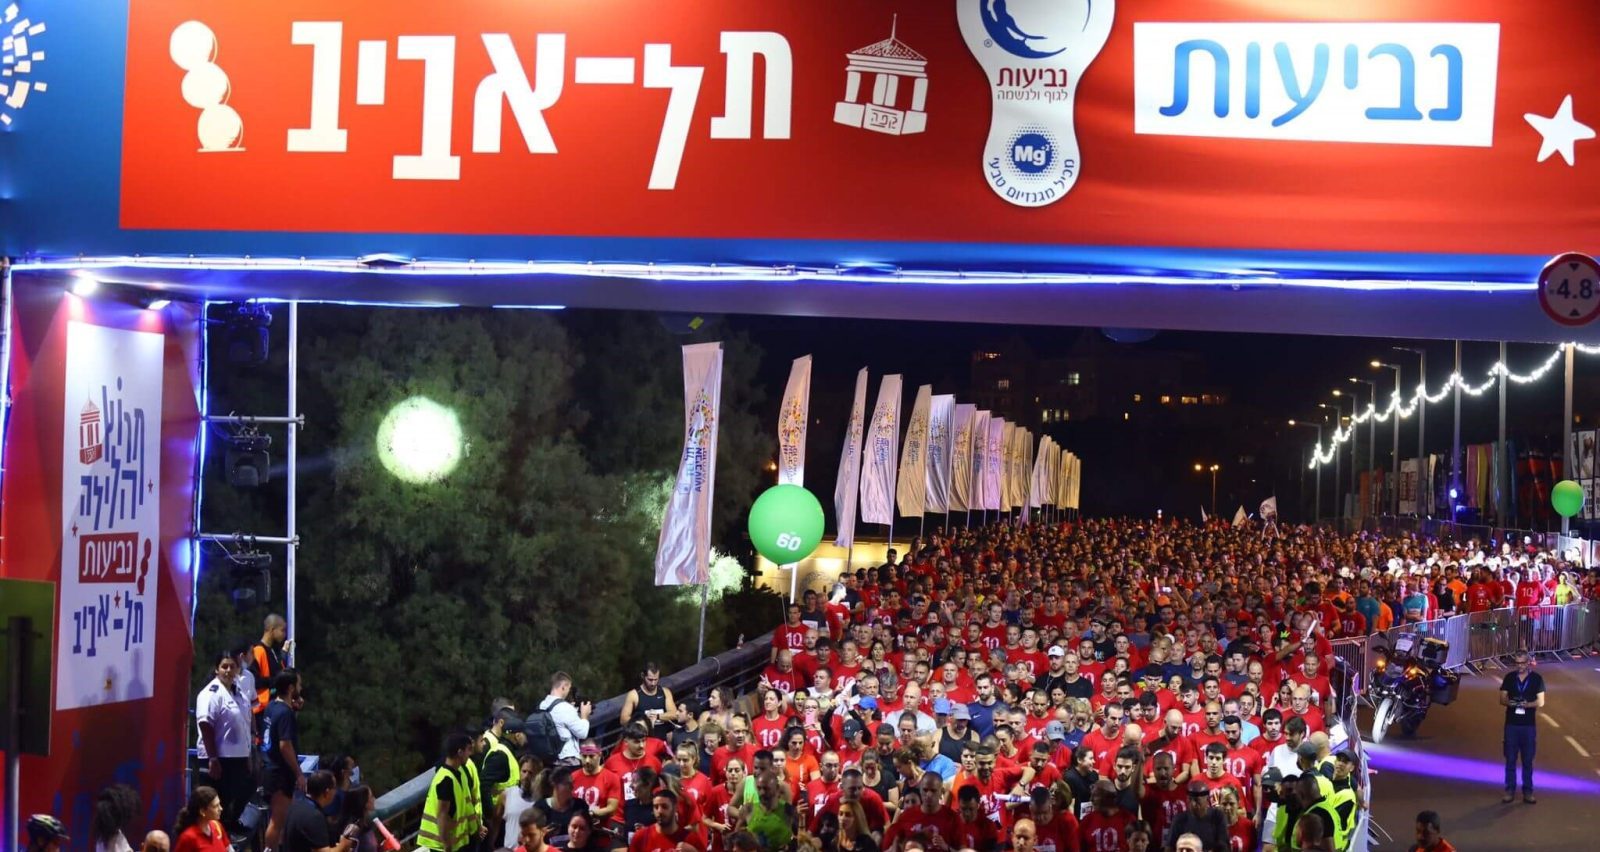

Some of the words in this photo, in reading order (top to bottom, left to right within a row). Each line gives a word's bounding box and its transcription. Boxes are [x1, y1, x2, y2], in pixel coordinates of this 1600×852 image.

[996, 67, 1067, 89] נביעות
[1158, 39, 1464, 127] נביעות
[997, 88, 1040, 101] ולנשמה
[1044, 88, 1068, 104] לגוף
[988, 157, 1007, 188] טבעי
[1053, 158, 1075, 190] מכיל
[1006, 187, 1056, 203] מגנזיום
[1556, 278, 1593, 300] 4.8
[80, 446, 138, 531] הלילה
[775, 532, 802, 551] 60
[82, 540, 133, 579] נביעות
[786, 632, 803, 647] 10
[983, 636, 999, 650] 10
[760, 728, 782, 748] 10
[1224, 757, 1247, 778] 10
[573, 785, 600, 807] 10
[1091, 827, 1119, 852] 10
